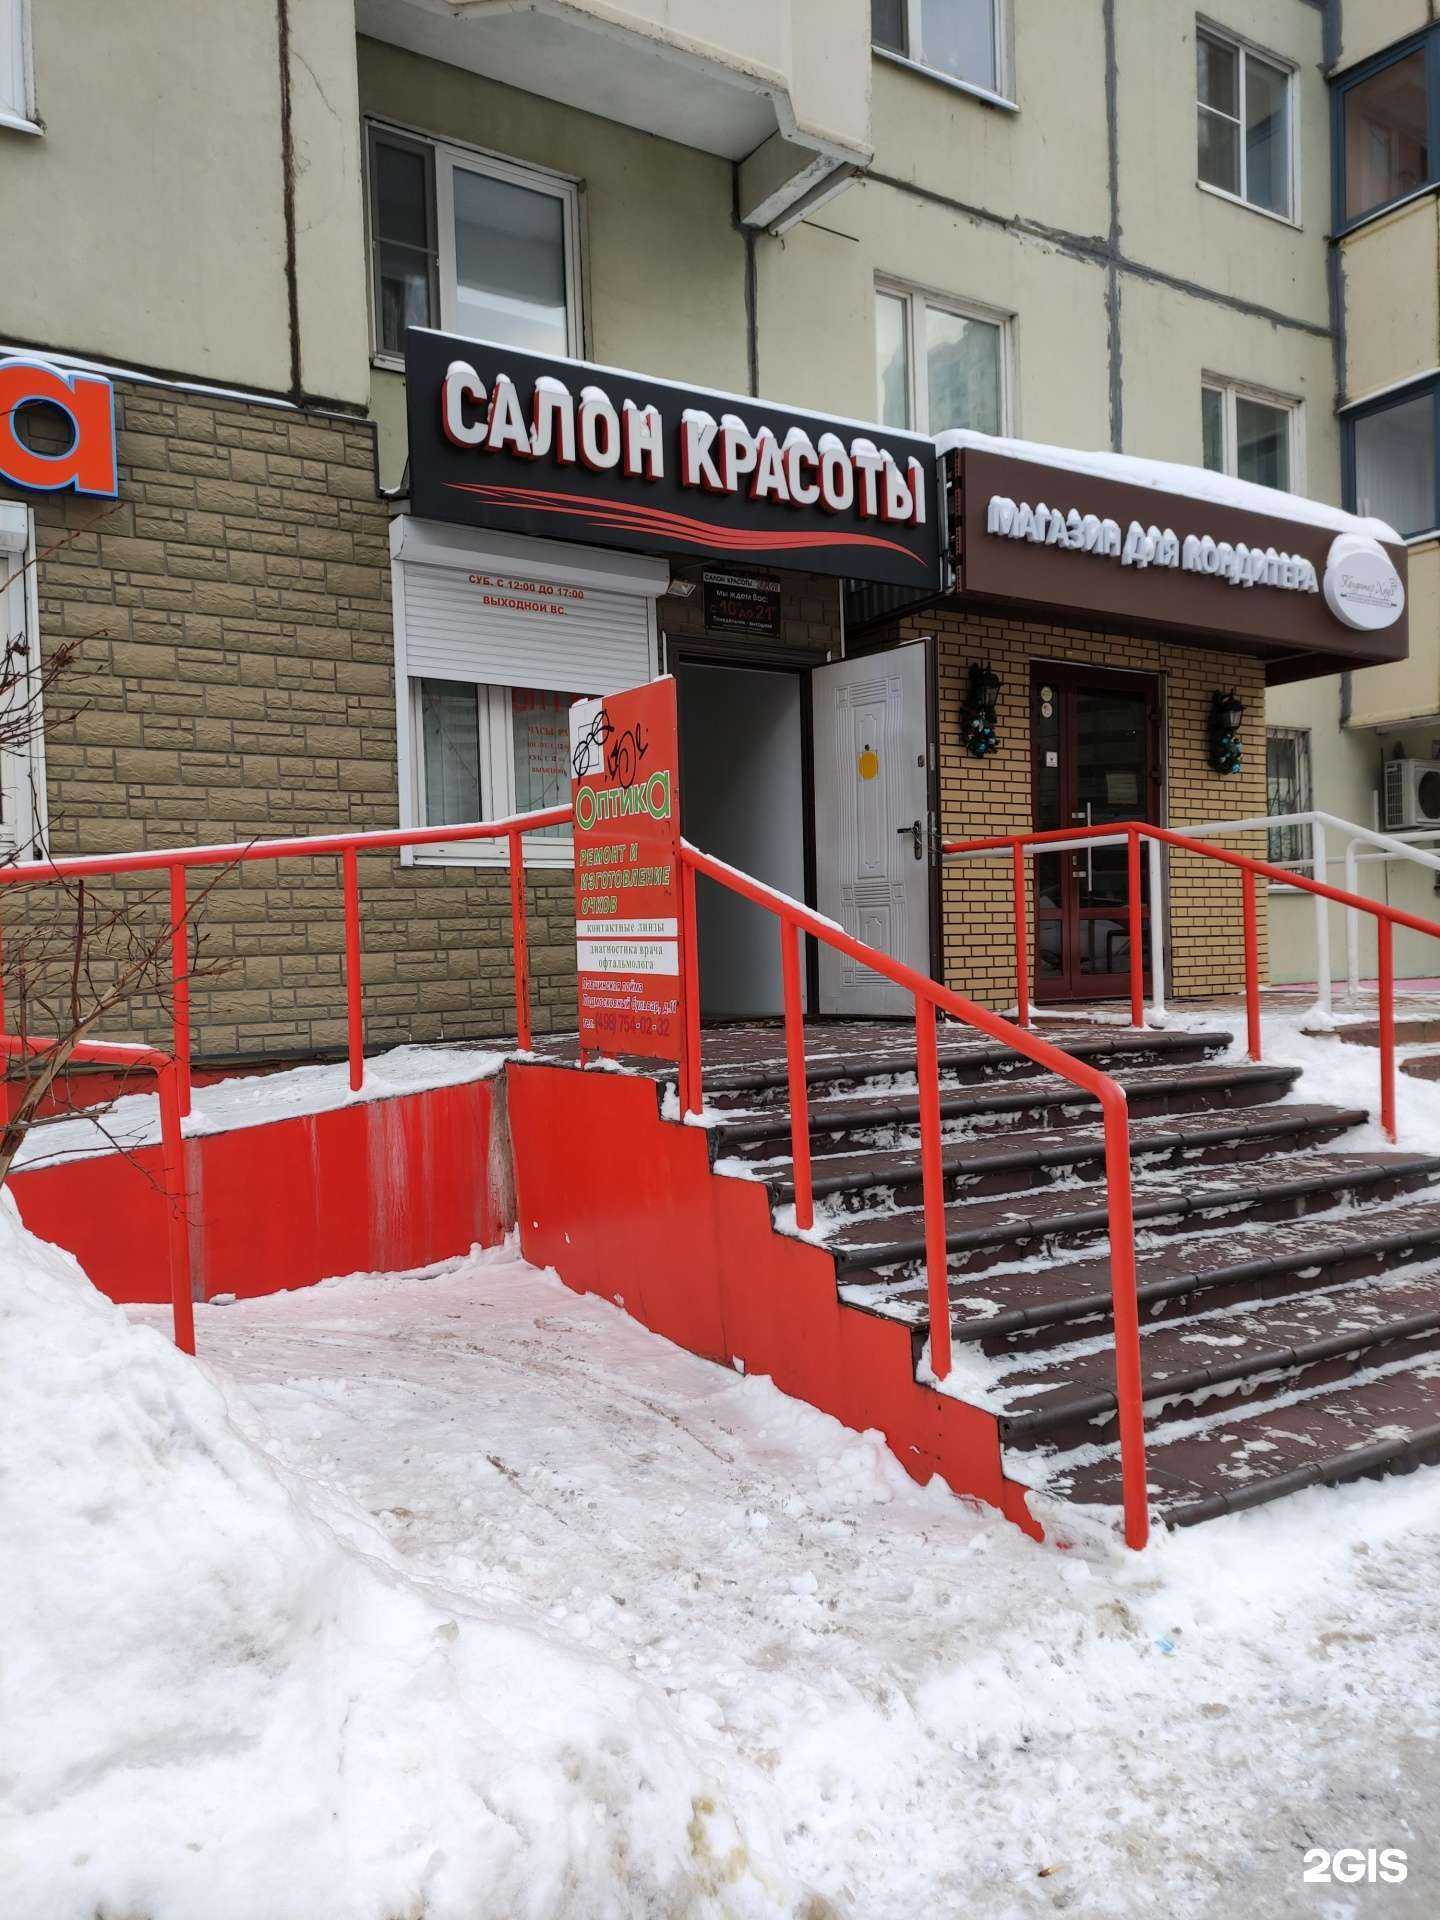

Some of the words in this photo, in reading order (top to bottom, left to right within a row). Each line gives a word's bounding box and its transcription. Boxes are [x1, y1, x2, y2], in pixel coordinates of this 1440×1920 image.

[442, 367, 664, 480] САЛОН
[681, 410, 926, 525] КРАСОТЫ
[468, 574, 494, 587] СУБ.
[497, 578, 504, 588] С
[508, 581, 535, 592] 12:00
[538, 585, 553, 595] ДО
[558, 588, 584, 600] 17:00
[550, 605, 568, 616] ВС.
[579, 844, 627, 867] РЕМОНТ
[629, 842, 639, 862] И
[580, 865, 671, 891] ИЗГОТОВЛЕНИЕ
[581, 895, 618, 915] ОЧКОВ
[598, 956, 654, 971] офтальмолога
